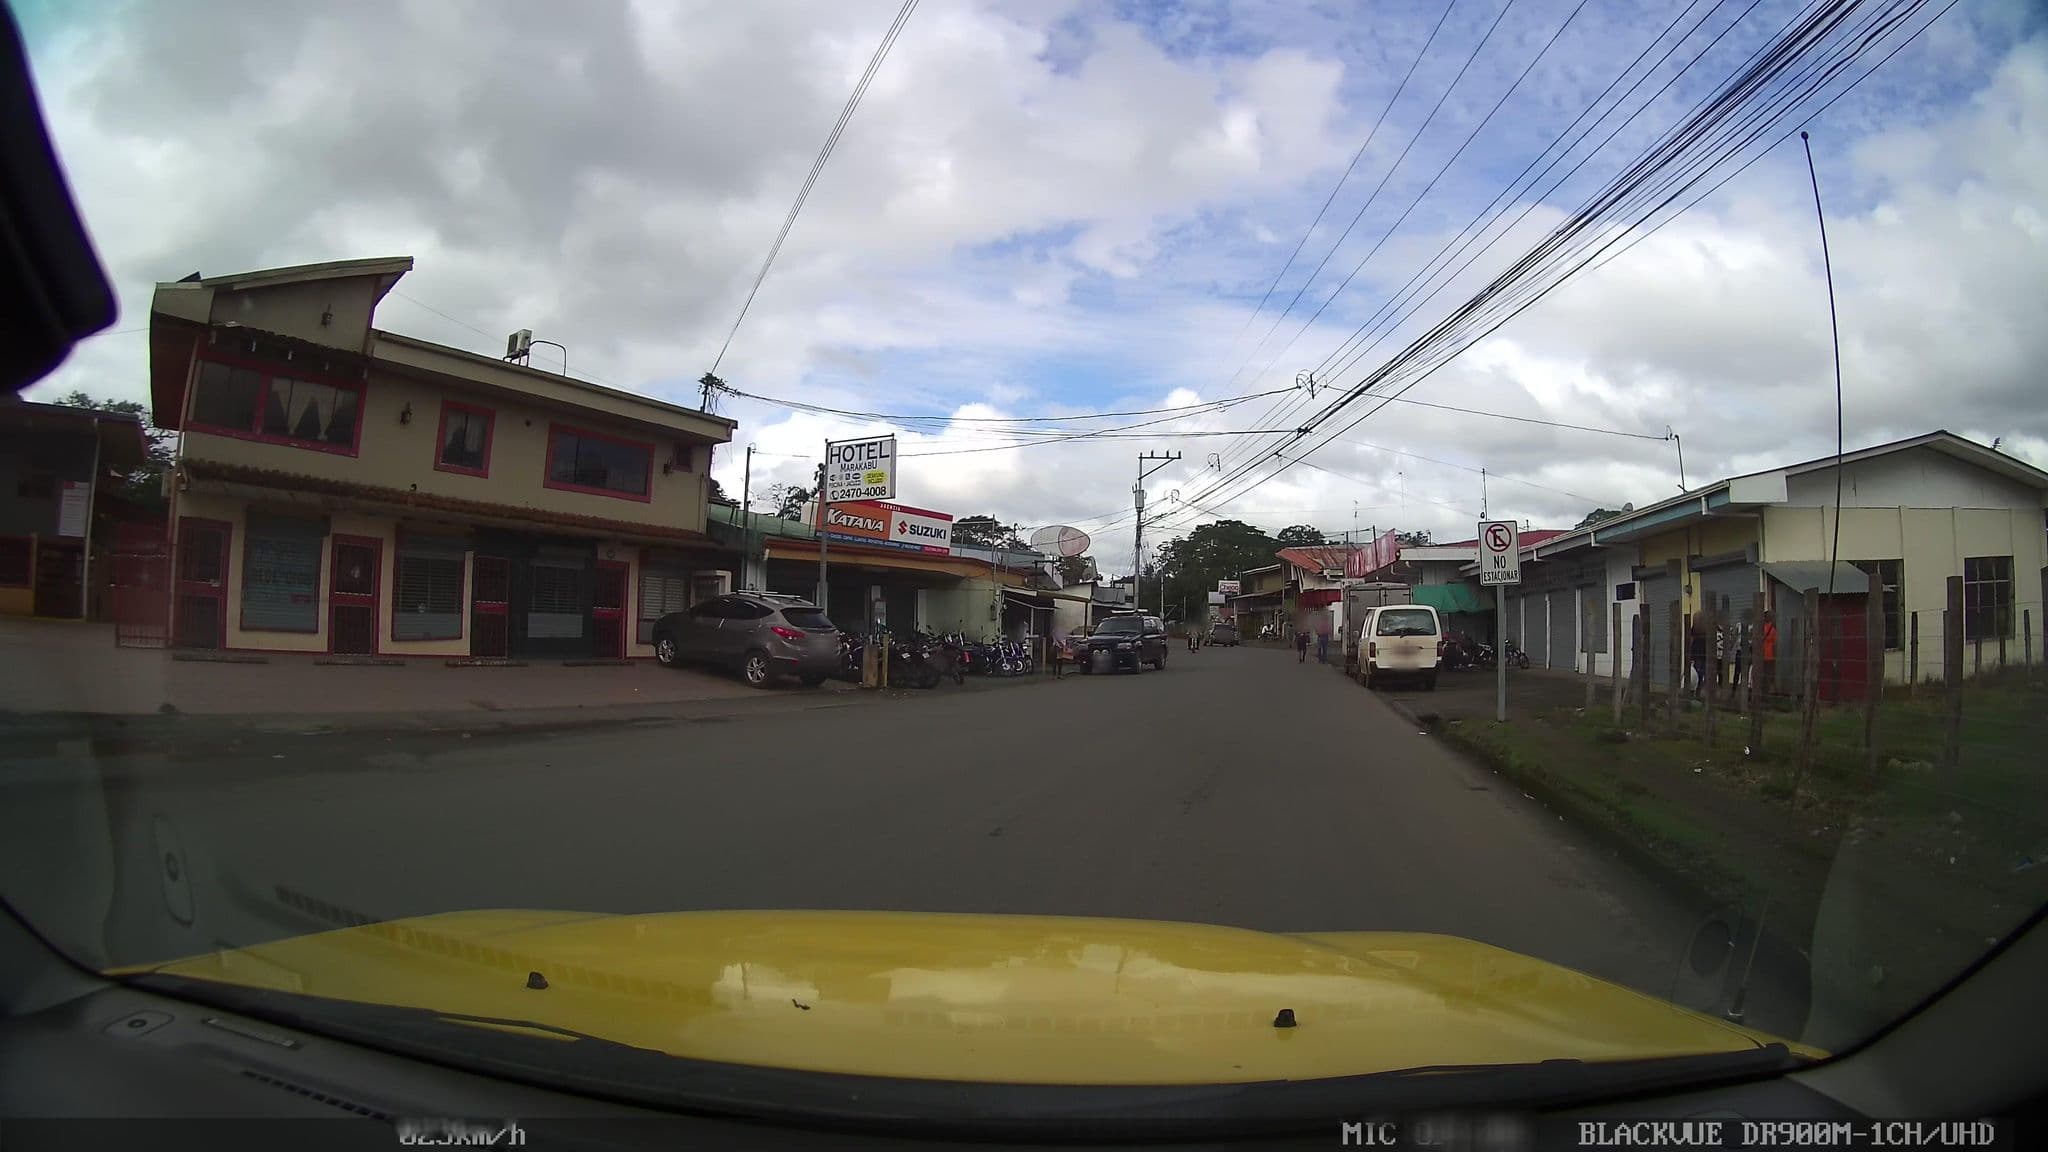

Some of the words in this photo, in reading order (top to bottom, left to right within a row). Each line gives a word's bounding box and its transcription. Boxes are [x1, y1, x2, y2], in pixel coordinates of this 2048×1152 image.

[829, 442, 889, 464] HOTEL
[840, 486, 886, 498] 2470-4008
[827, 508, 884, 532] KATANA
[909, 524, 946, 539] SUZUKI
[1494, 555, 1506, 569] NO
[1484, 570, 1518, 581] ESTACIONAR
